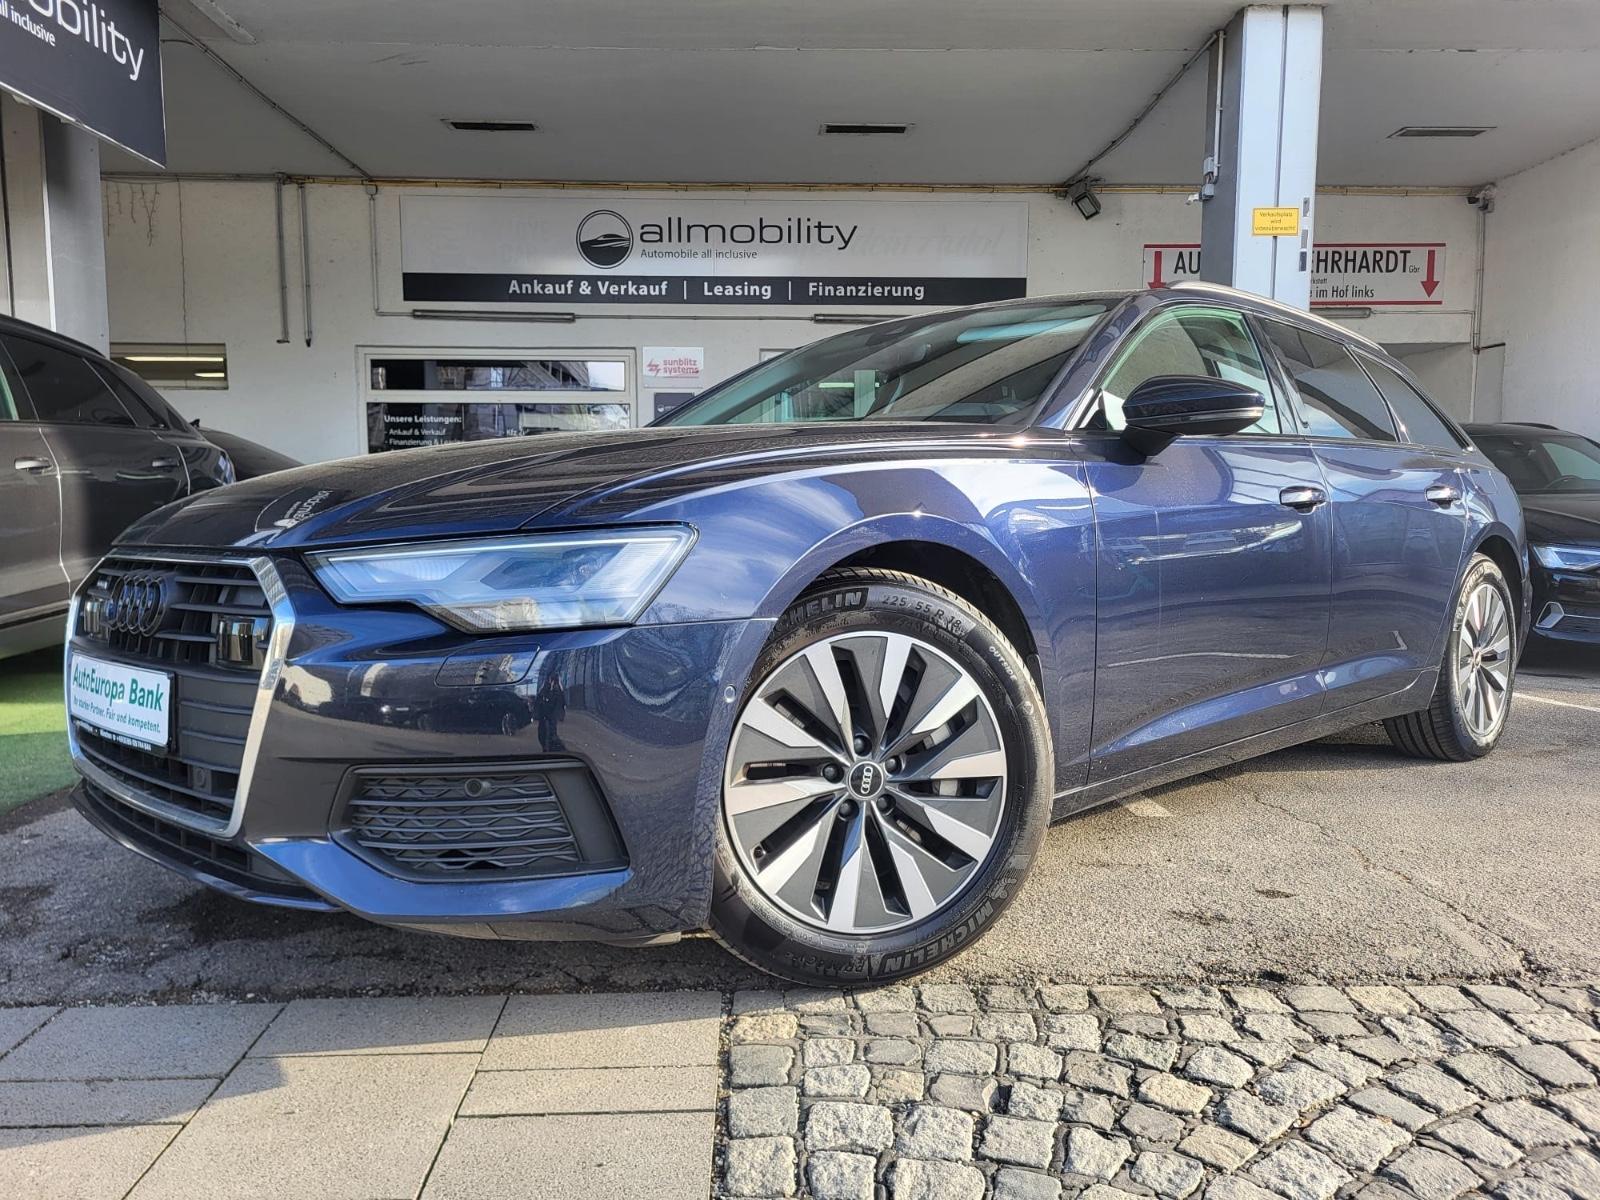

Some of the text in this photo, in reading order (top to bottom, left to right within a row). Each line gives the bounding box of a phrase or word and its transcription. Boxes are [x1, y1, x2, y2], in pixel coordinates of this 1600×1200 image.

[10, 5, 56, 47] inclusive
[640, 217, 857, 250] allmobility
[641, 249, 758, 259] Automobile all inclusive
[1173, 249, 1420, 274] AU HRHARDT Gbr
[508, 279, 925, 300] Ankauf & Verkauf Leasing Finanzierung
[1315, 285, 1374, 298] im Hof links
[663, 358, 697, 366] sunblitz
[663, 366, 699, 375] systems
[384, 414, 462, 425] Unsere Leistungen:
[389, 428, 447, 436] Ankauf & Verkauf
[989, 646, 1018, 681] OUTSIDE
[72, 663, 164, 712] AutoEuropa Bank
[106, 707, 116, 720] Fair
[116, 711, 127, 724] und
[127, 712, 161, 733] kompetent.
[884, 901, 994, 973] MICHELIN
